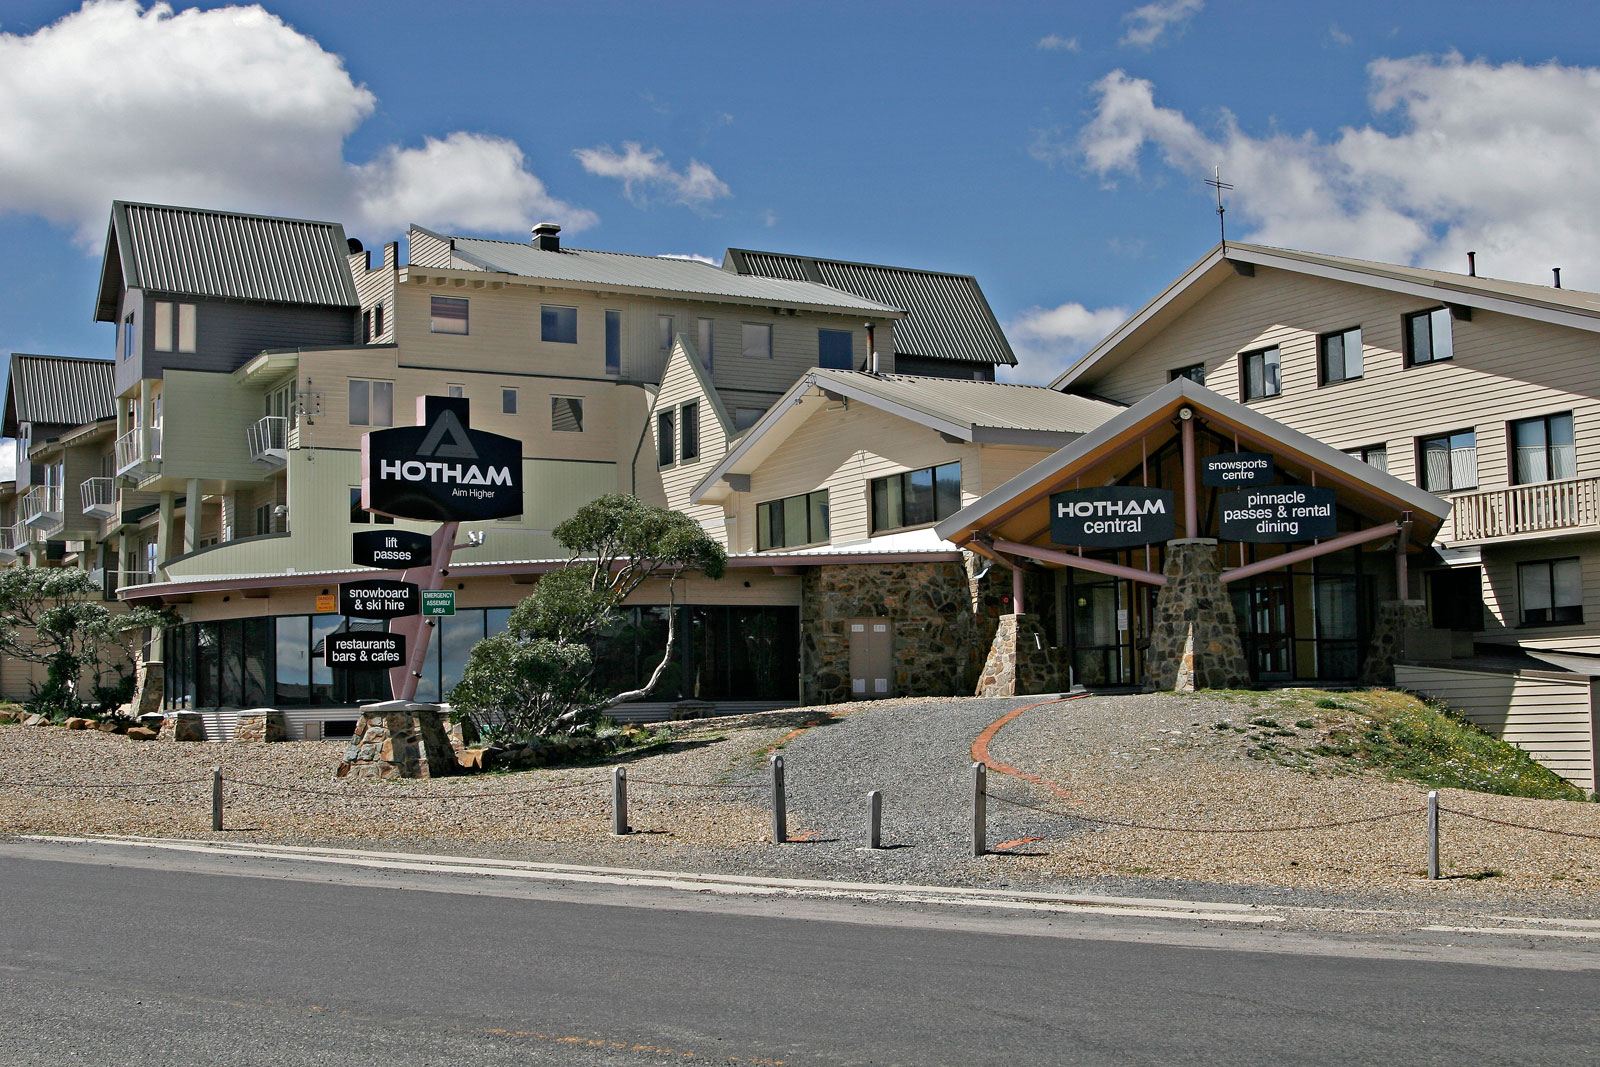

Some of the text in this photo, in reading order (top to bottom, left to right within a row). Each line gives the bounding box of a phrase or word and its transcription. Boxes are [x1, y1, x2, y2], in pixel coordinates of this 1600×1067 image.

[1207, 458, 1268, 472] snowsports
[380, 459, 513, 487] HOTHAM
[1222, 470, 1255, 481] centre
[452, 487, 495, 500] Aim Higher
[1247, 491, 1306, 509] pinnacle
[1057, 498, 1166, 519] HOTHAM
[1223, 503, 1332, 523] passes & rental
[1083, 516, 1142, 534] central
[1255, 519, 1299, 535] dining
[385, 536, 398, 548] lift
[373, 550, 412, 562] passes
[349, 587, 409, 599] snowboard
[354, 599, 405, 611] & ski hire
[336, 638, 396, 650] restaurants
[332, 650, 400, 662] bars & cafes
